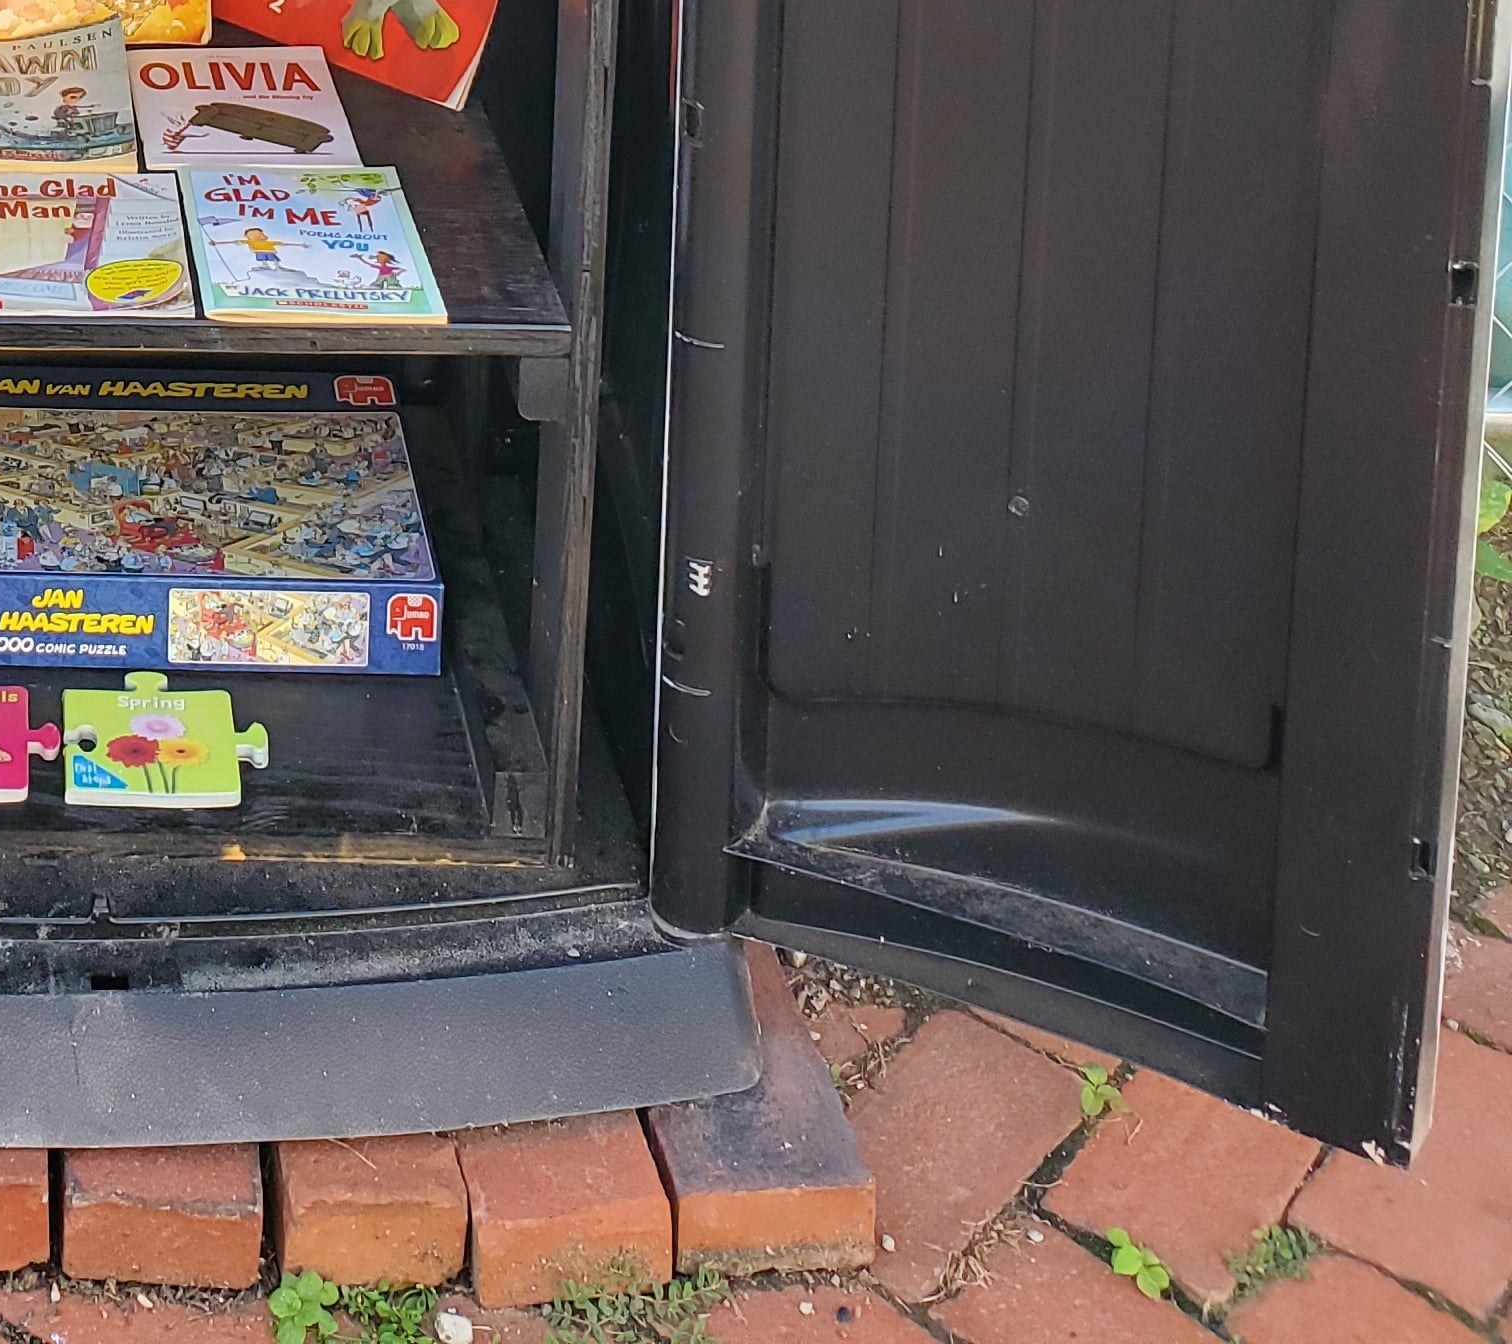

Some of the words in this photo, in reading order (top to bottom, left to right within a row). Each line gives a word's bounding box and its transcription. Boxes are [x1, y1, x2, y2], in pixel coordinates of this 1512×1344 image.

[12, 28, 113, 51] PAULSEN
[139, 61, 322, 92] OLIVIA
[39, 177, 117, 199] Glad
[223, 174, 261, 186] I'M
[204, 188, 290, 203] GLAD
[239, 204, 274, 220] I'M
[286, 207, 341, 226] ME
[299, 229, 341, 239] POEMS
[347, 232, 388, 241] ABOUT
[322, 239, 369, 252] YOU
[238, 285, 289, 297] JACK
[296, 288, 409, 301] PRELUTSKY
[98, 378, 309, 400] HAASTEREN
[31, 587, 85, 610] JAN
[36, 641, 76, 655] COMIC
[78, 642, 127, 657] PUZZLE
[402, 641, 425, 652] 17018
[117, 694, 186, 714] Spring
